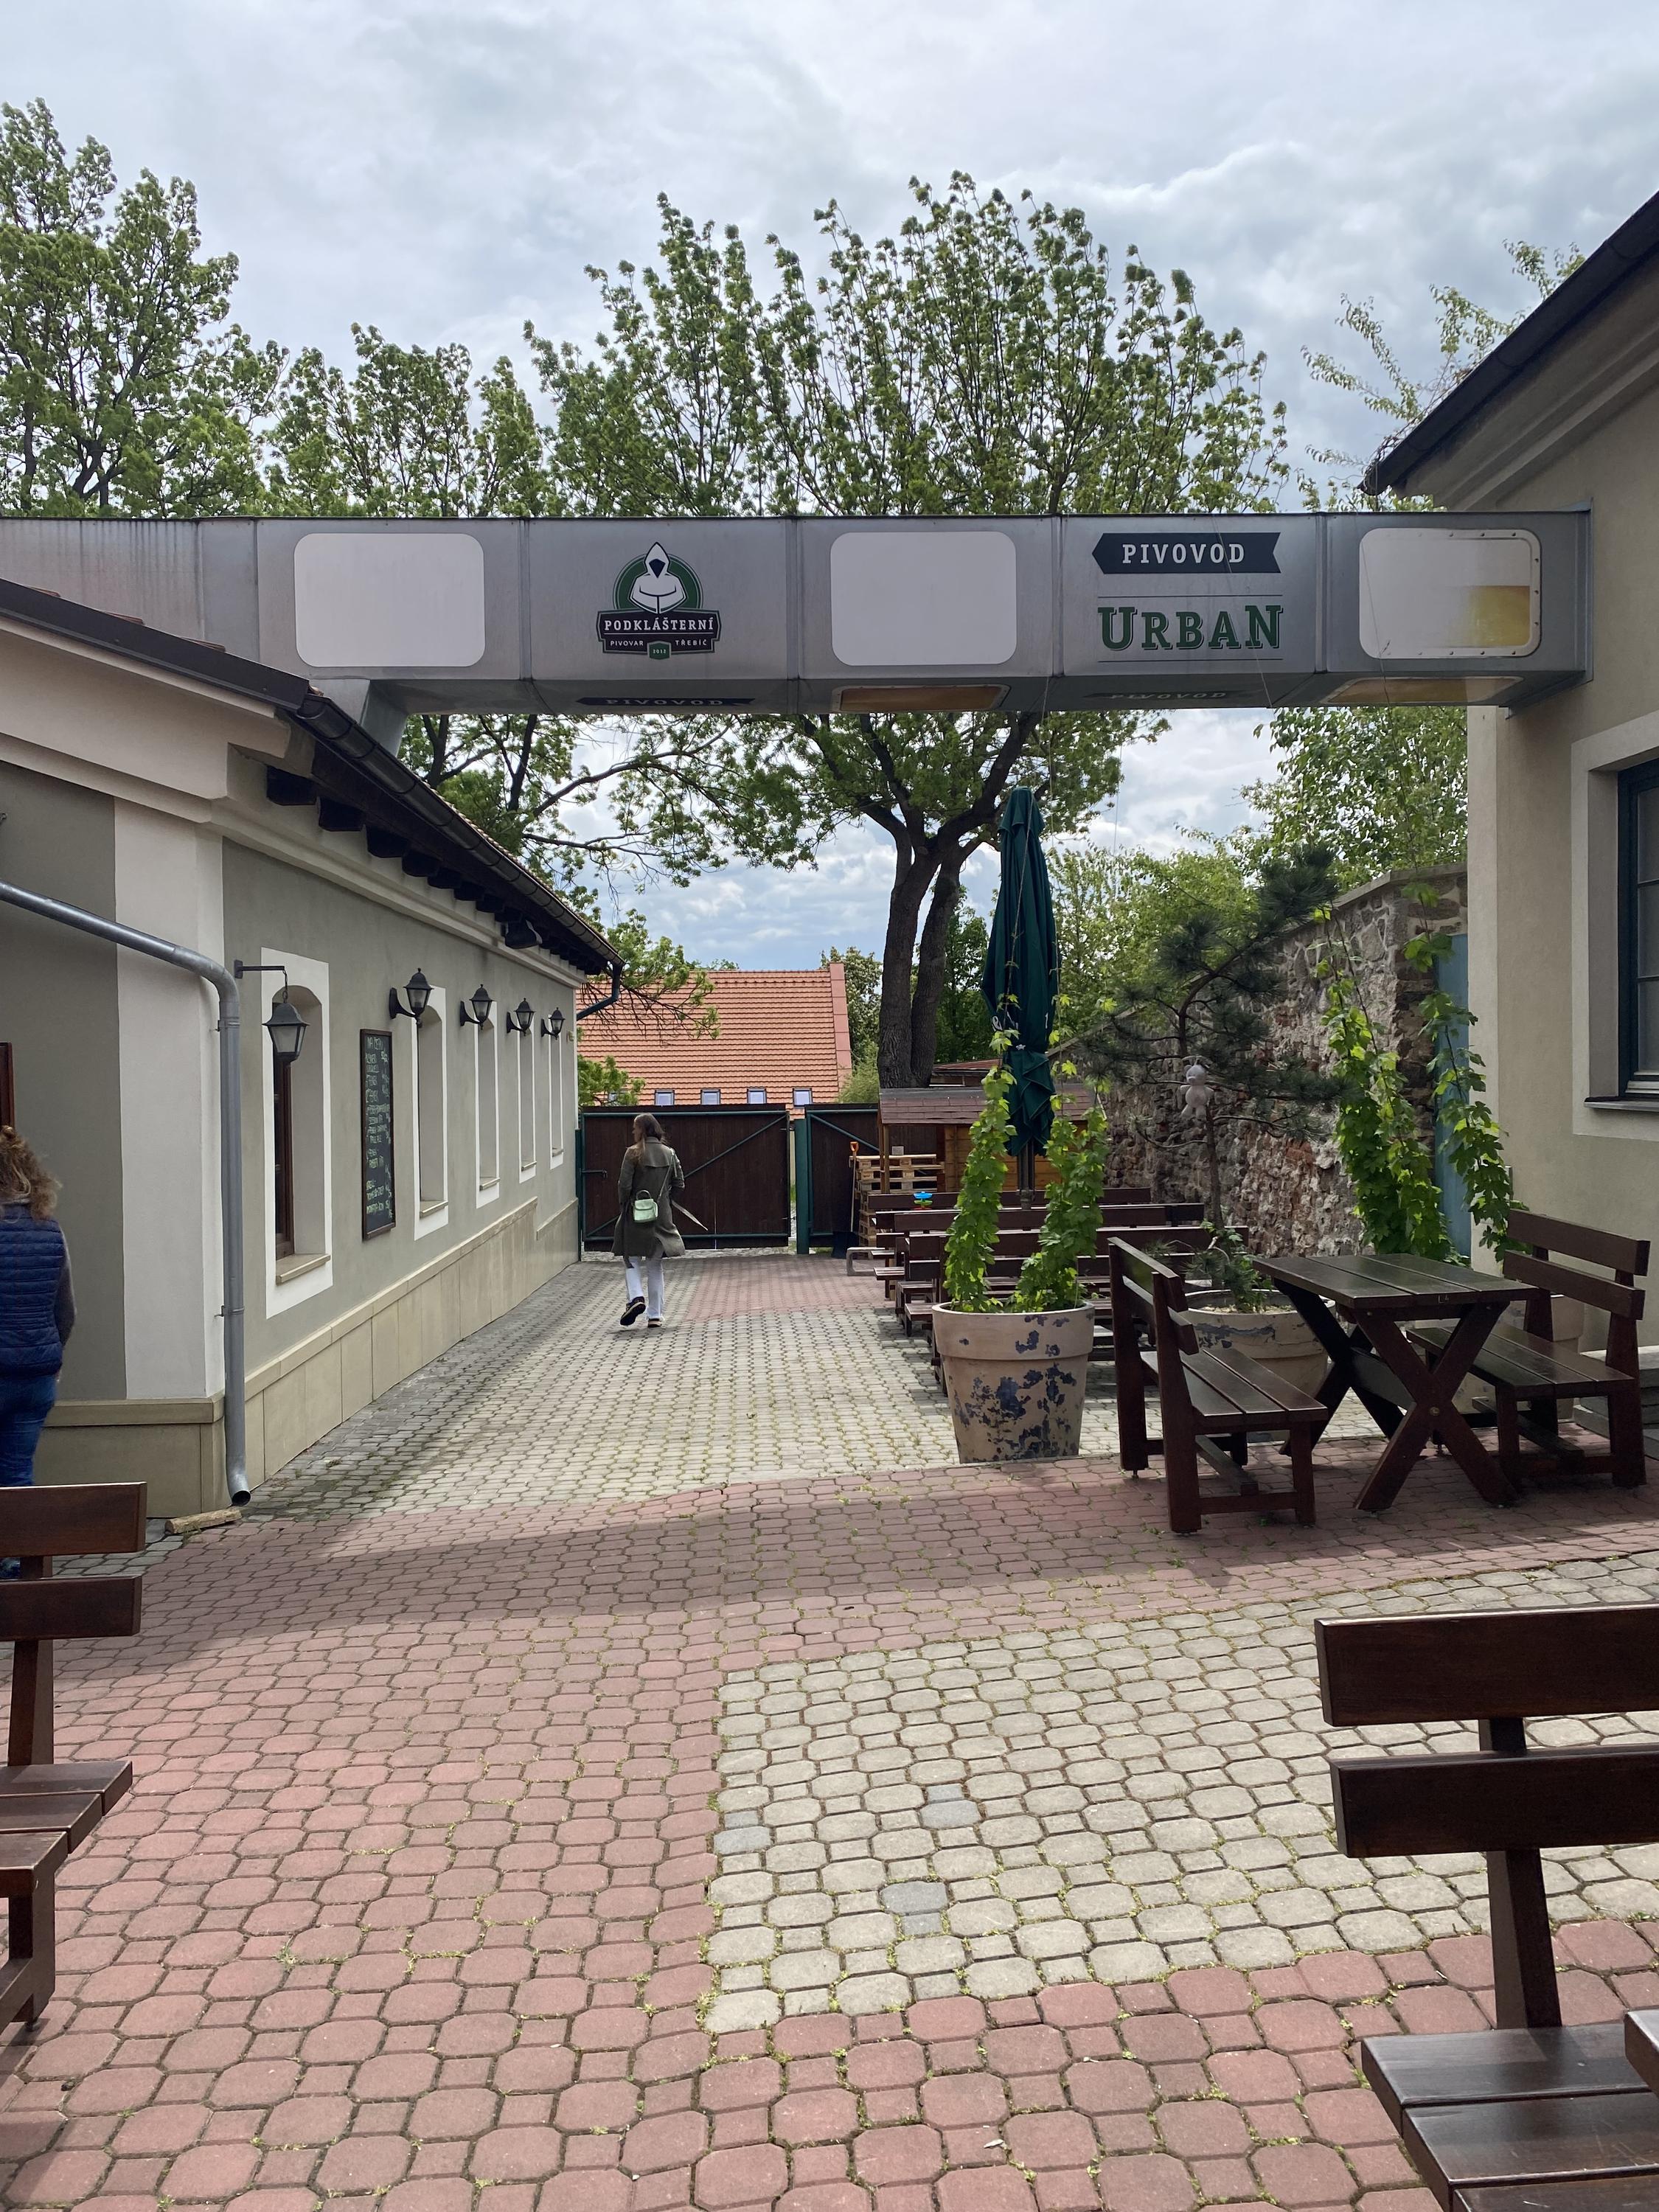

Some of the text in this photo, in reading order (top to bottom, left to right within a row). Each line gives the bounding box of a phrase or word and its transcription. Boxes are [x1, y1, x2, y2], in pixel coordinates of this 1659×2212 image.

[1122, 543, 1245, 564] PIVOVOD
[604, 616, 714, 630] PODKLÁŠTERNÍ
[1098, 605, 1284, 650] URBAN
[675, 638, 707, 646] TŘEBÍČ
